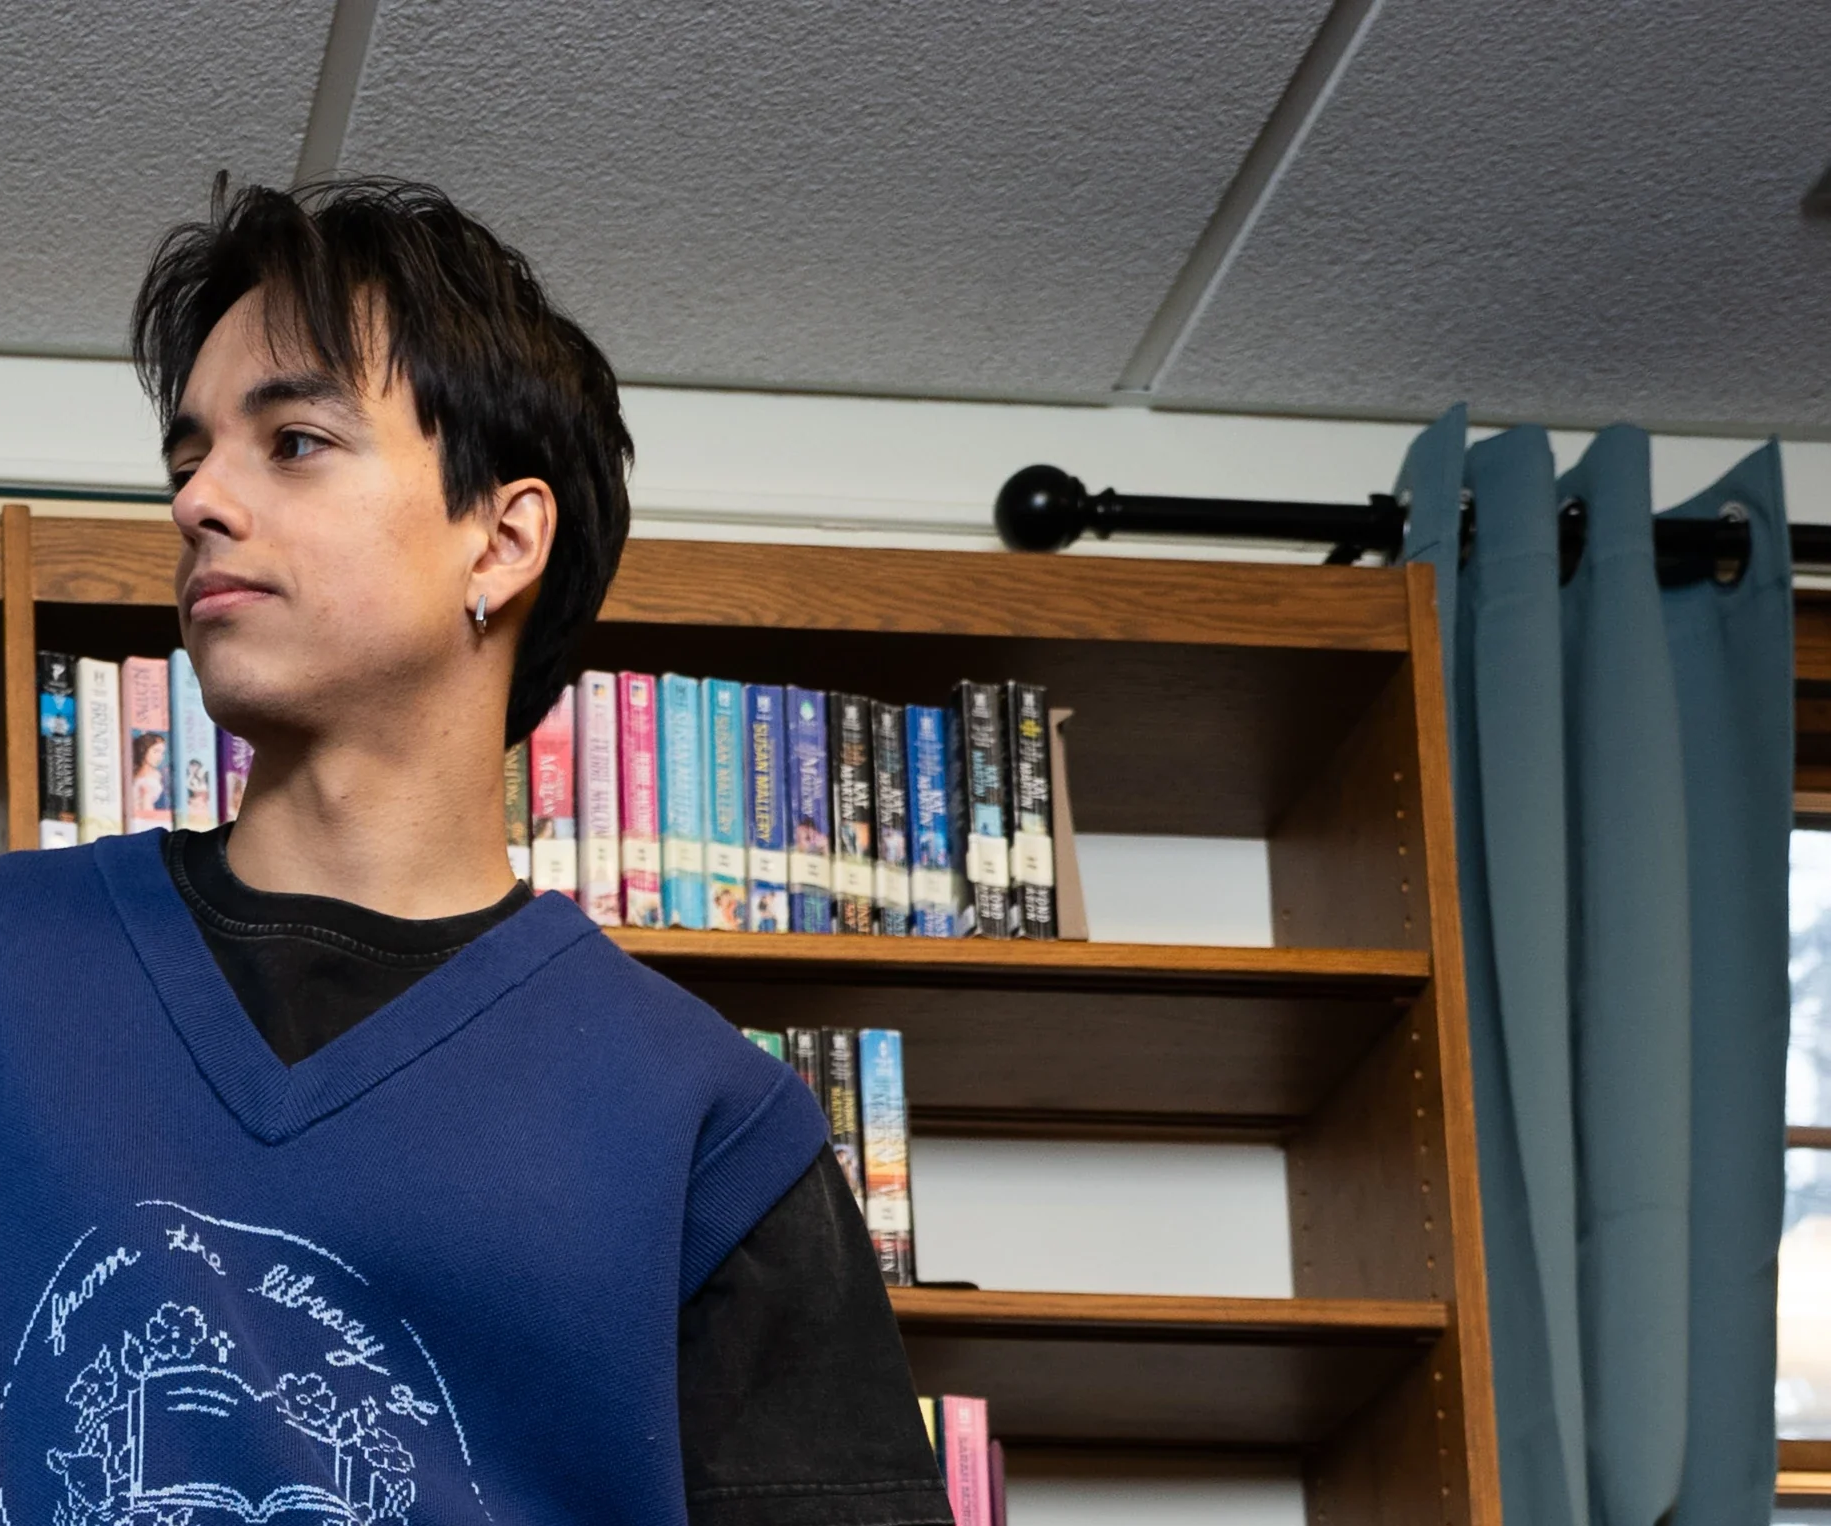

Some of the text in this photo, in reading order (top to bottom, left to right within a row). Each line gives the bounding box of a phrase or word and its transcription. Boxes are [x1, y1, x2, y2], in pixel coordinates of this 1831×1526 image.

[44, 1247, 140, 1355] from
[166, 1224, 226, 1275] the
[247, 1264, 390, 1375] library
